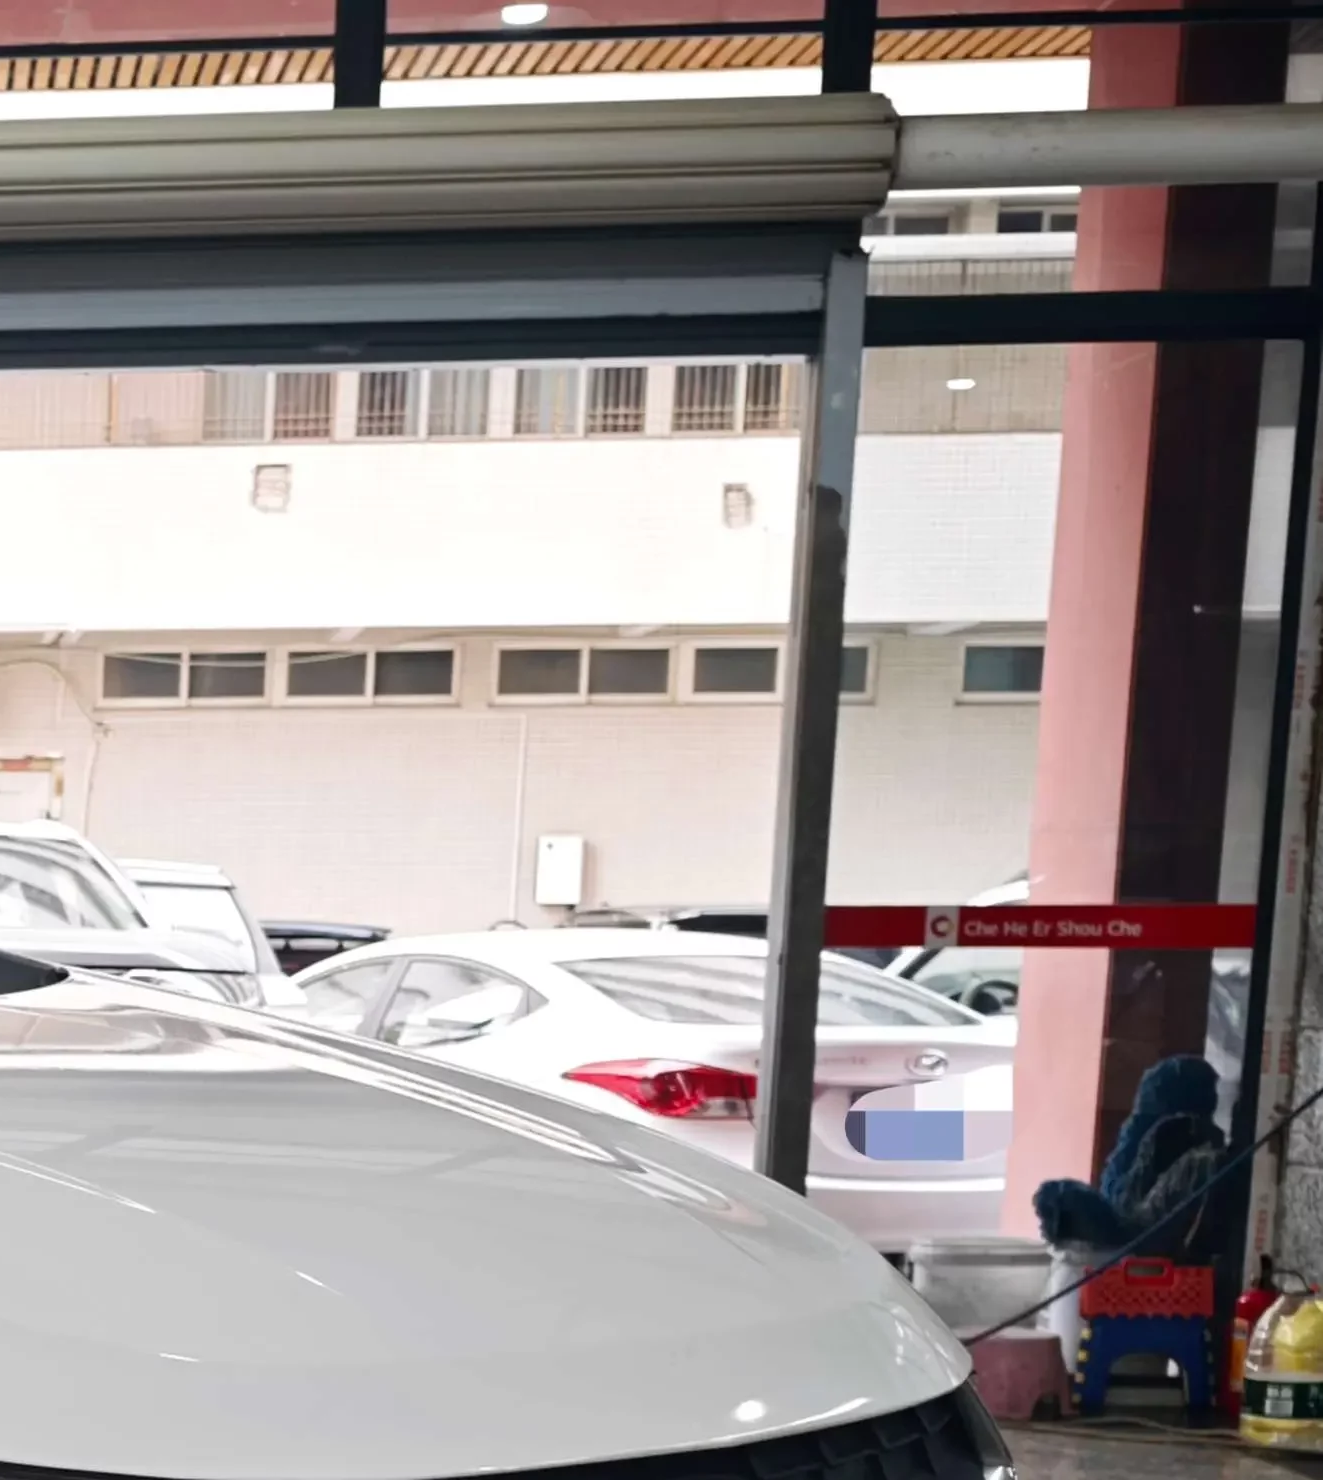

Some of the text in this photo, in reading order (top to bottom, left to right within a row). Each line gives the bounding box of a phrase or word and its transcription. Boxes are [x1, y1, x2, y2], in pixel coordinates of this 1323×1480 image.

[963, 919, 1143, 937] Che He Er Shou Che
